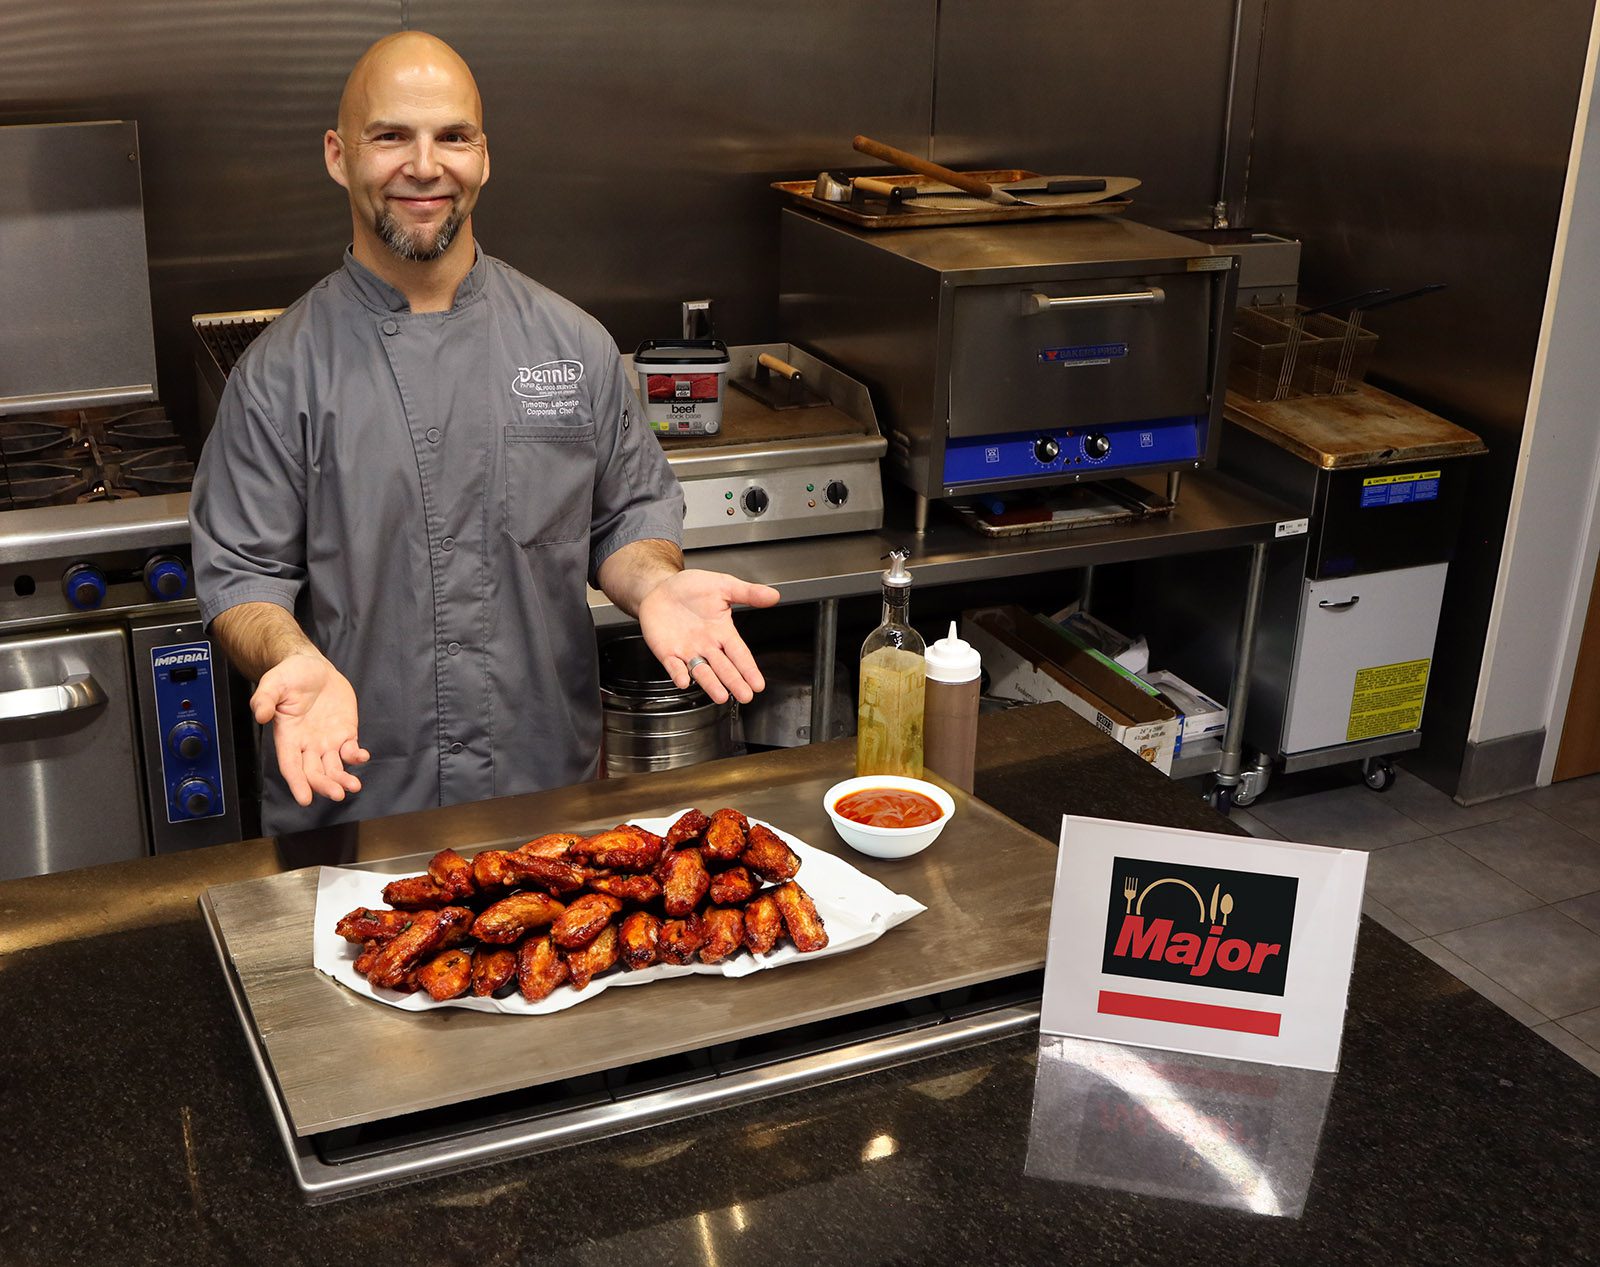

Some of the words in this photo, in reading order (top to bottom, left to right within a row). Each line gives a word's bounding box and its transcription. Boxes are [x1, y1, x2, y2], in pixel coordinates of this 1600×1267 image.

[518, 364, 576, 382] Dennis
[521, 401, 548, 409] Timothy
[671, 404, 696, 414] beef
[526, 408, 557, 416] Corporate
[559, 407, 575, 415] Chef
[154, 652, 209, 667] IMPERIAL
[1113, 915, 1282, 977] Major
